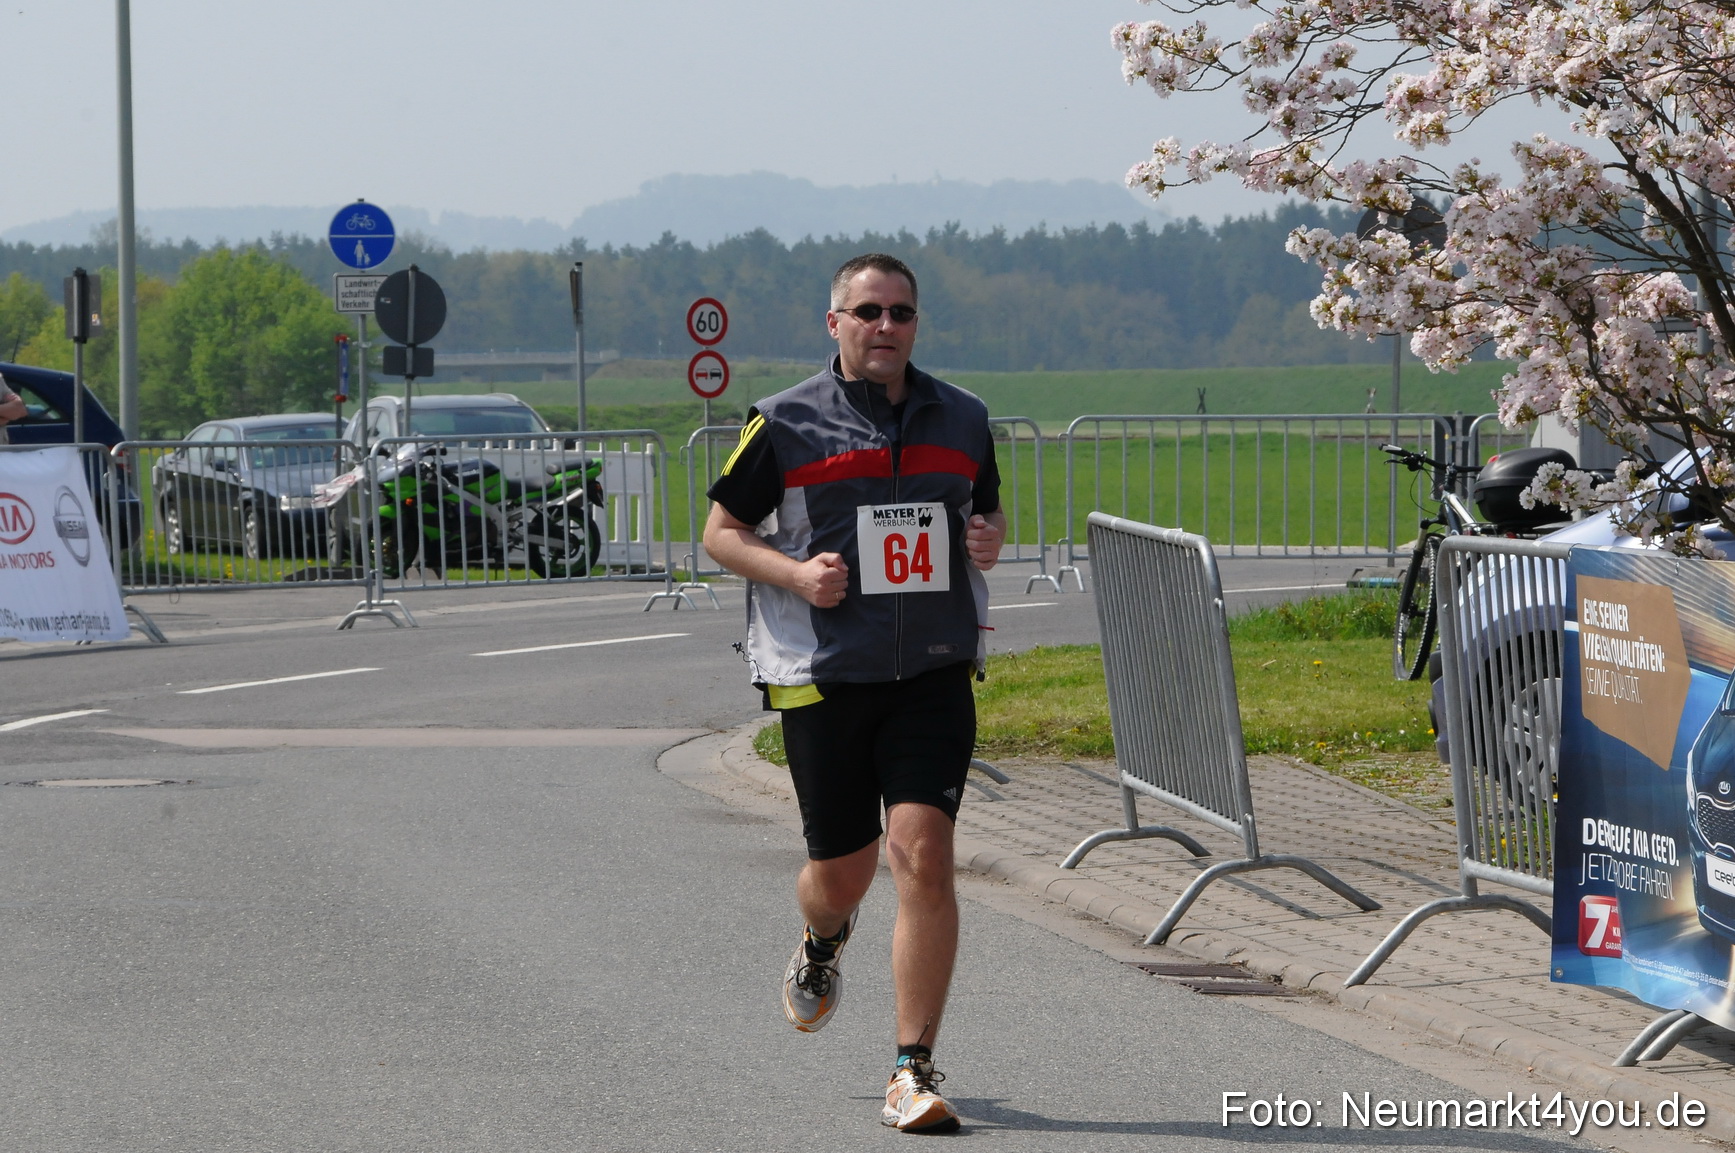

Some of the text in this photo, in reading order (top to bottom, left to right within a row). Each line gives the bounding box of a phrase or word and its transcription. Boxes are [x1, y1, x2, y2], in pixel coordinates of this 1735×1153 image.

[344, 279, 382, 288] Landwirt-
[341, 300, 370, 309] Verkehr
[696, 311, 719, 333] 60
[0, 505, 27, 532] IA
[873, 508, 915, 519] MEYER
[873, 518, 917, 528] WERBUNG
[8, 550, 55, 570] MOTORS
[883, 532, 934, 585] 64
[1599, 600, 1630, 632] SEINER
[1633, 828, 1650, 860] KIA
[1585, 903, 1611, 949] 7
